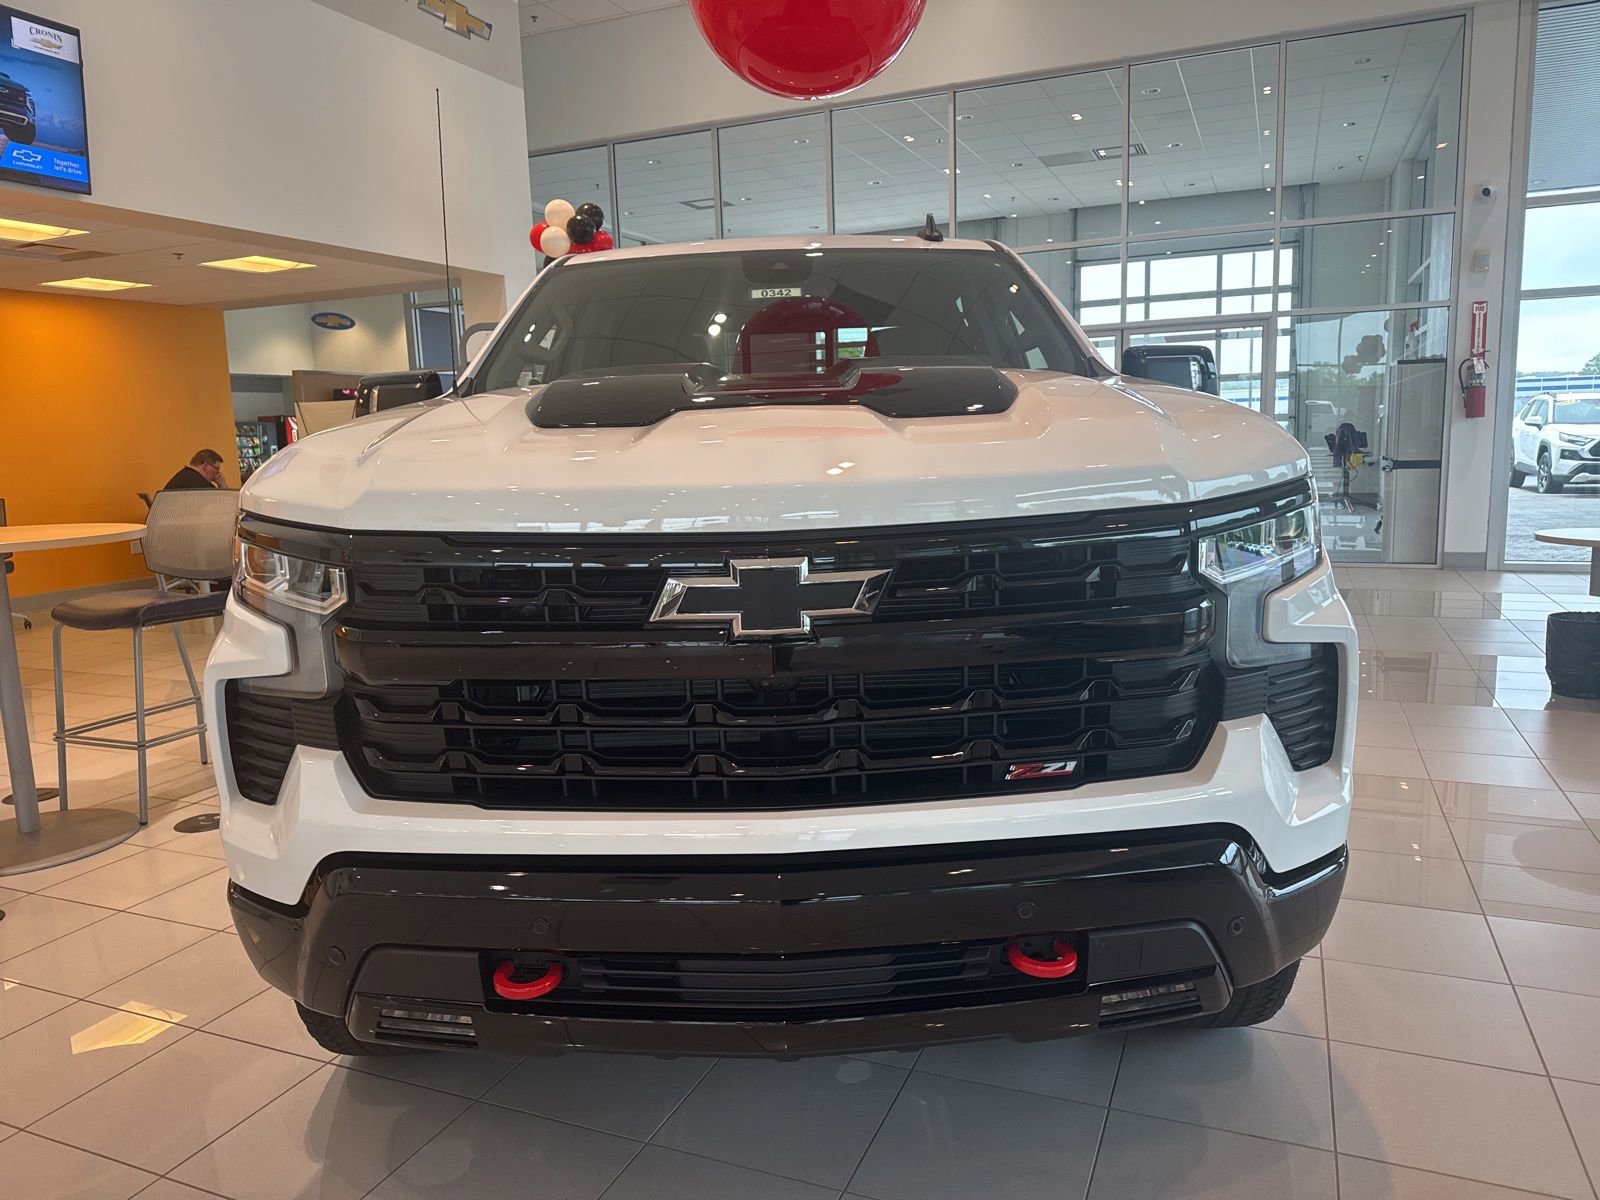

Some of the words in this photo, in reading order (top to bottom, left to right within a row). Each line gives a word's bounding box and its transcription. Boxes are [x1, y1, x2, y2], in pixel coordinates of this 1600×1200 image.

[29, 26, 63, 44] CRONIN
[67, 167, 83, 176] drive
[761, 288, 792, 298] 0342
